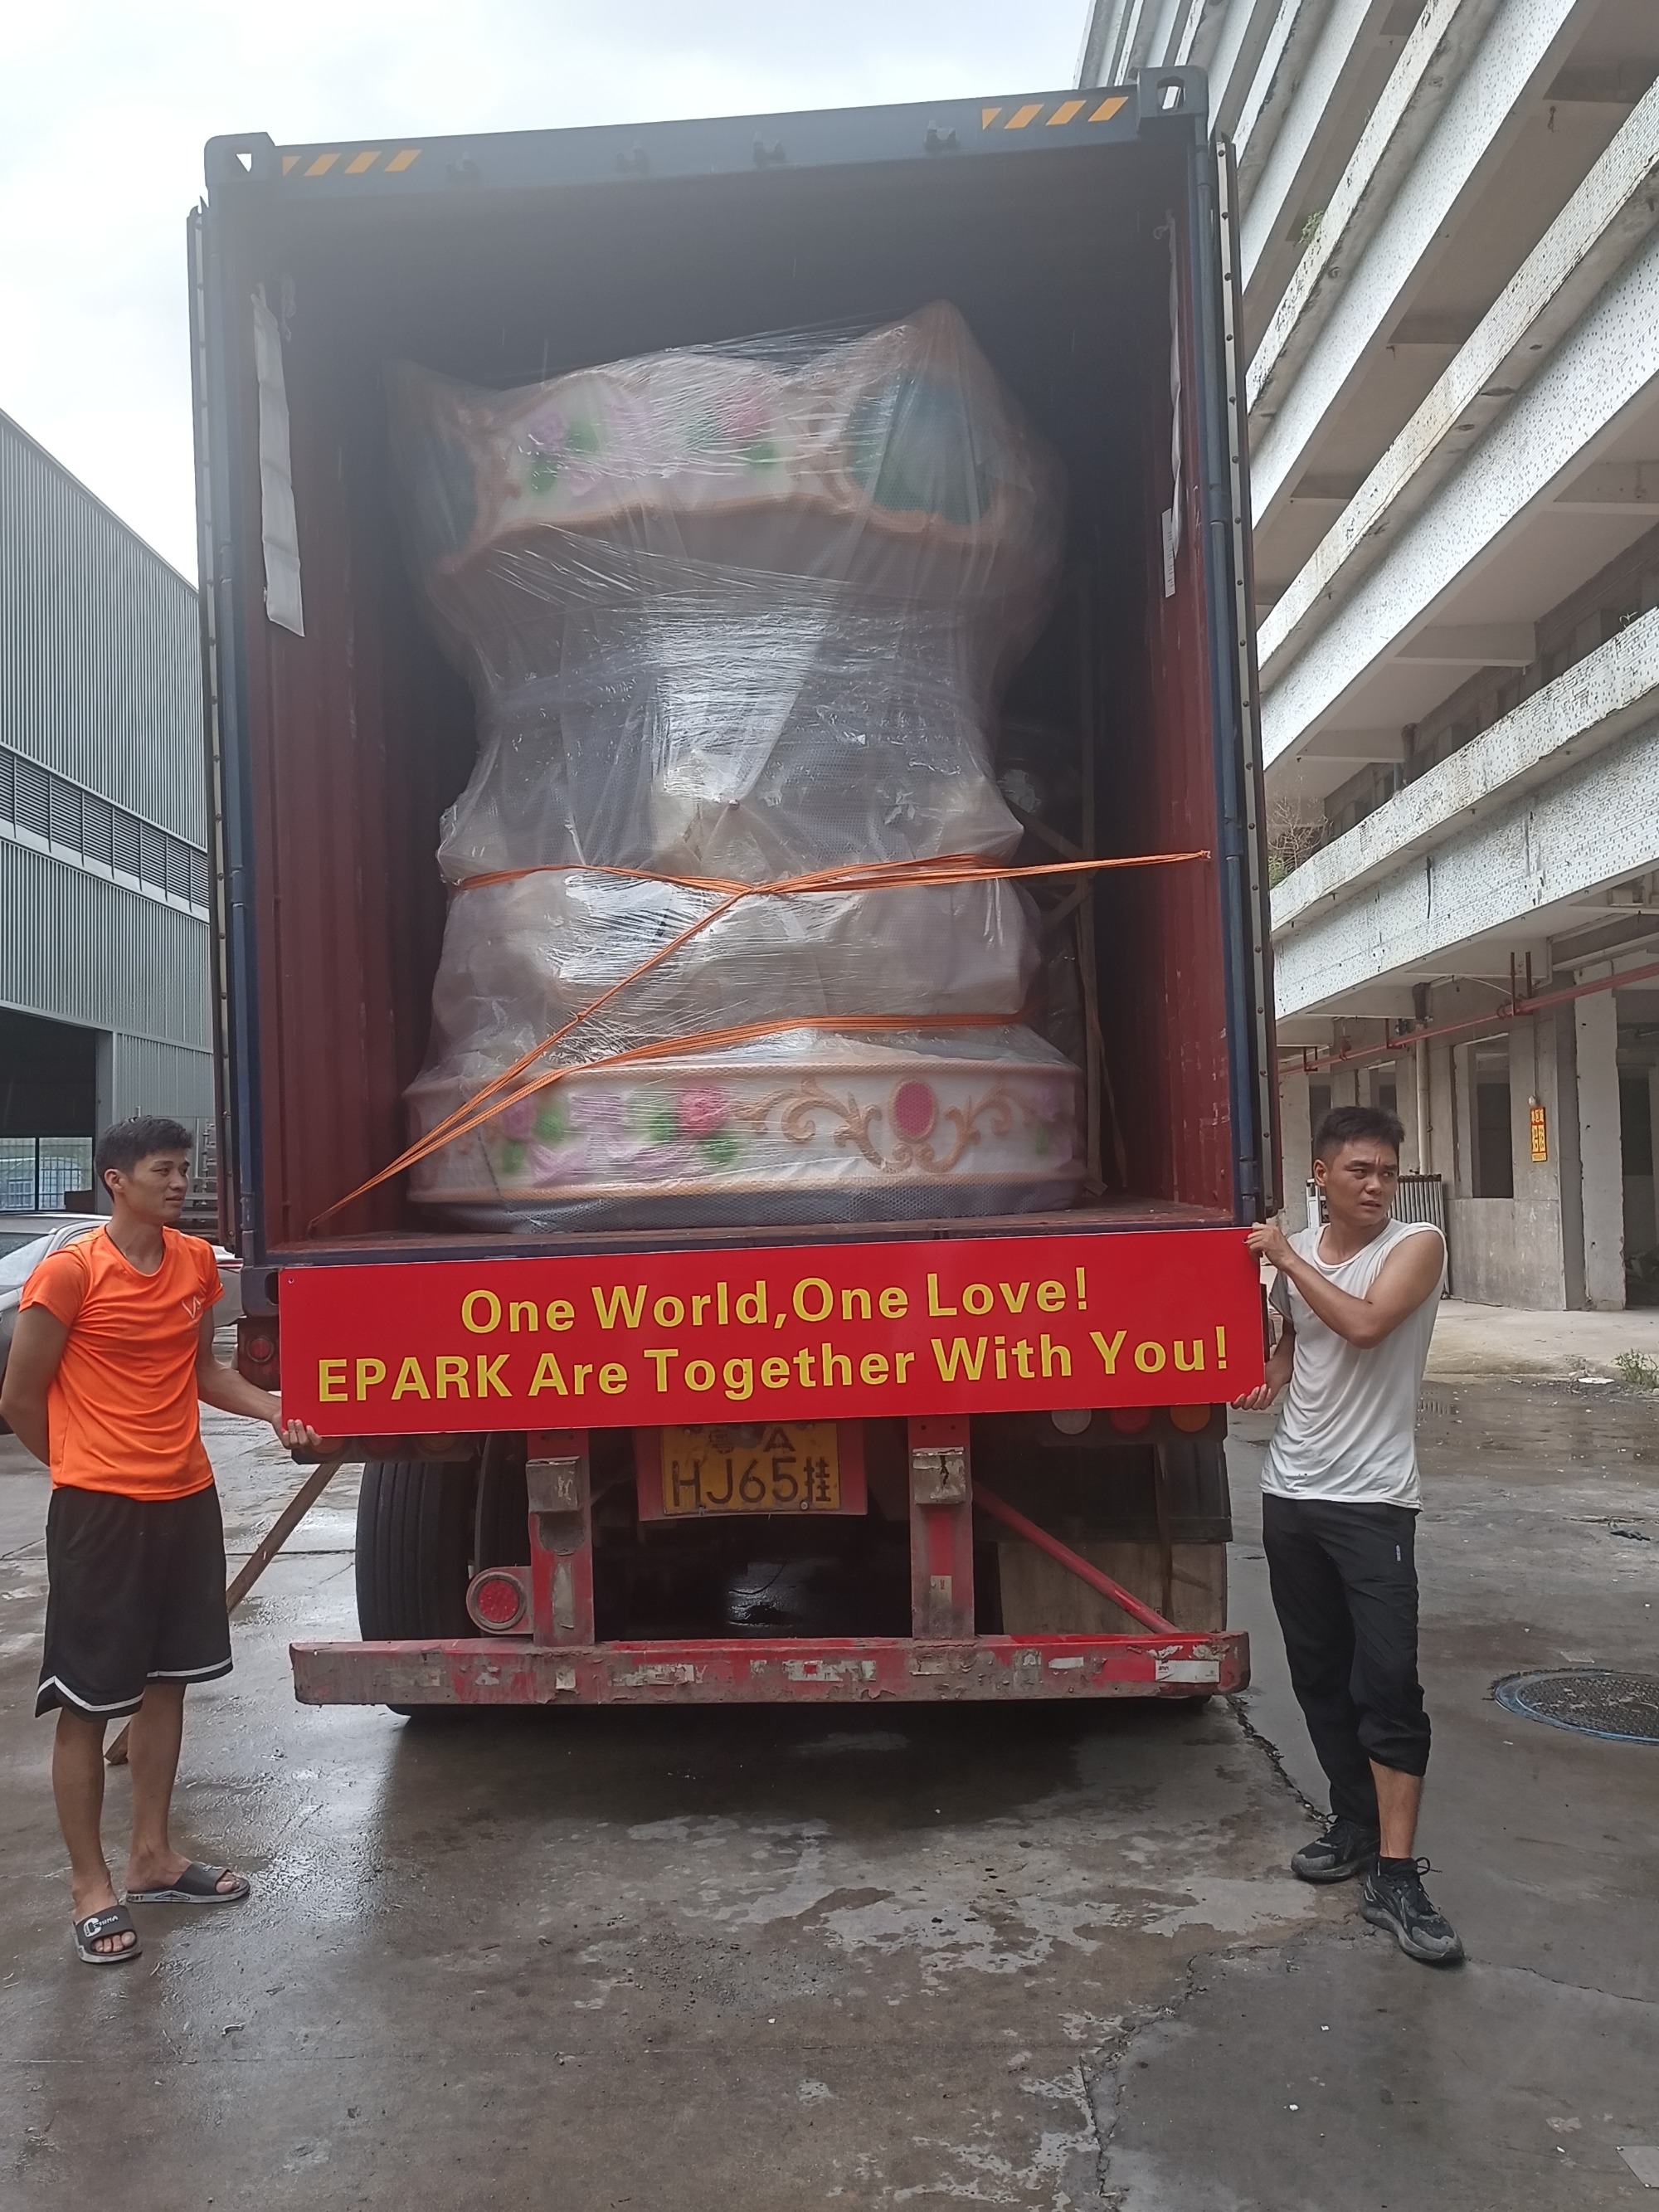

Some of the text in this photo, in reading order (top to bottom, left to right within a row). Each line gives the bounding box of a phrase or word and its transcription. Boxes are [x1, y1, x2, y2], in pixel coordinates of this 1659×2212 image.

[461, 1289, 575, 1333] One
[927, 1266, 1087, 1317] Love!
[319, 1326, 1227, 1402] EPARK Are Together With You!
